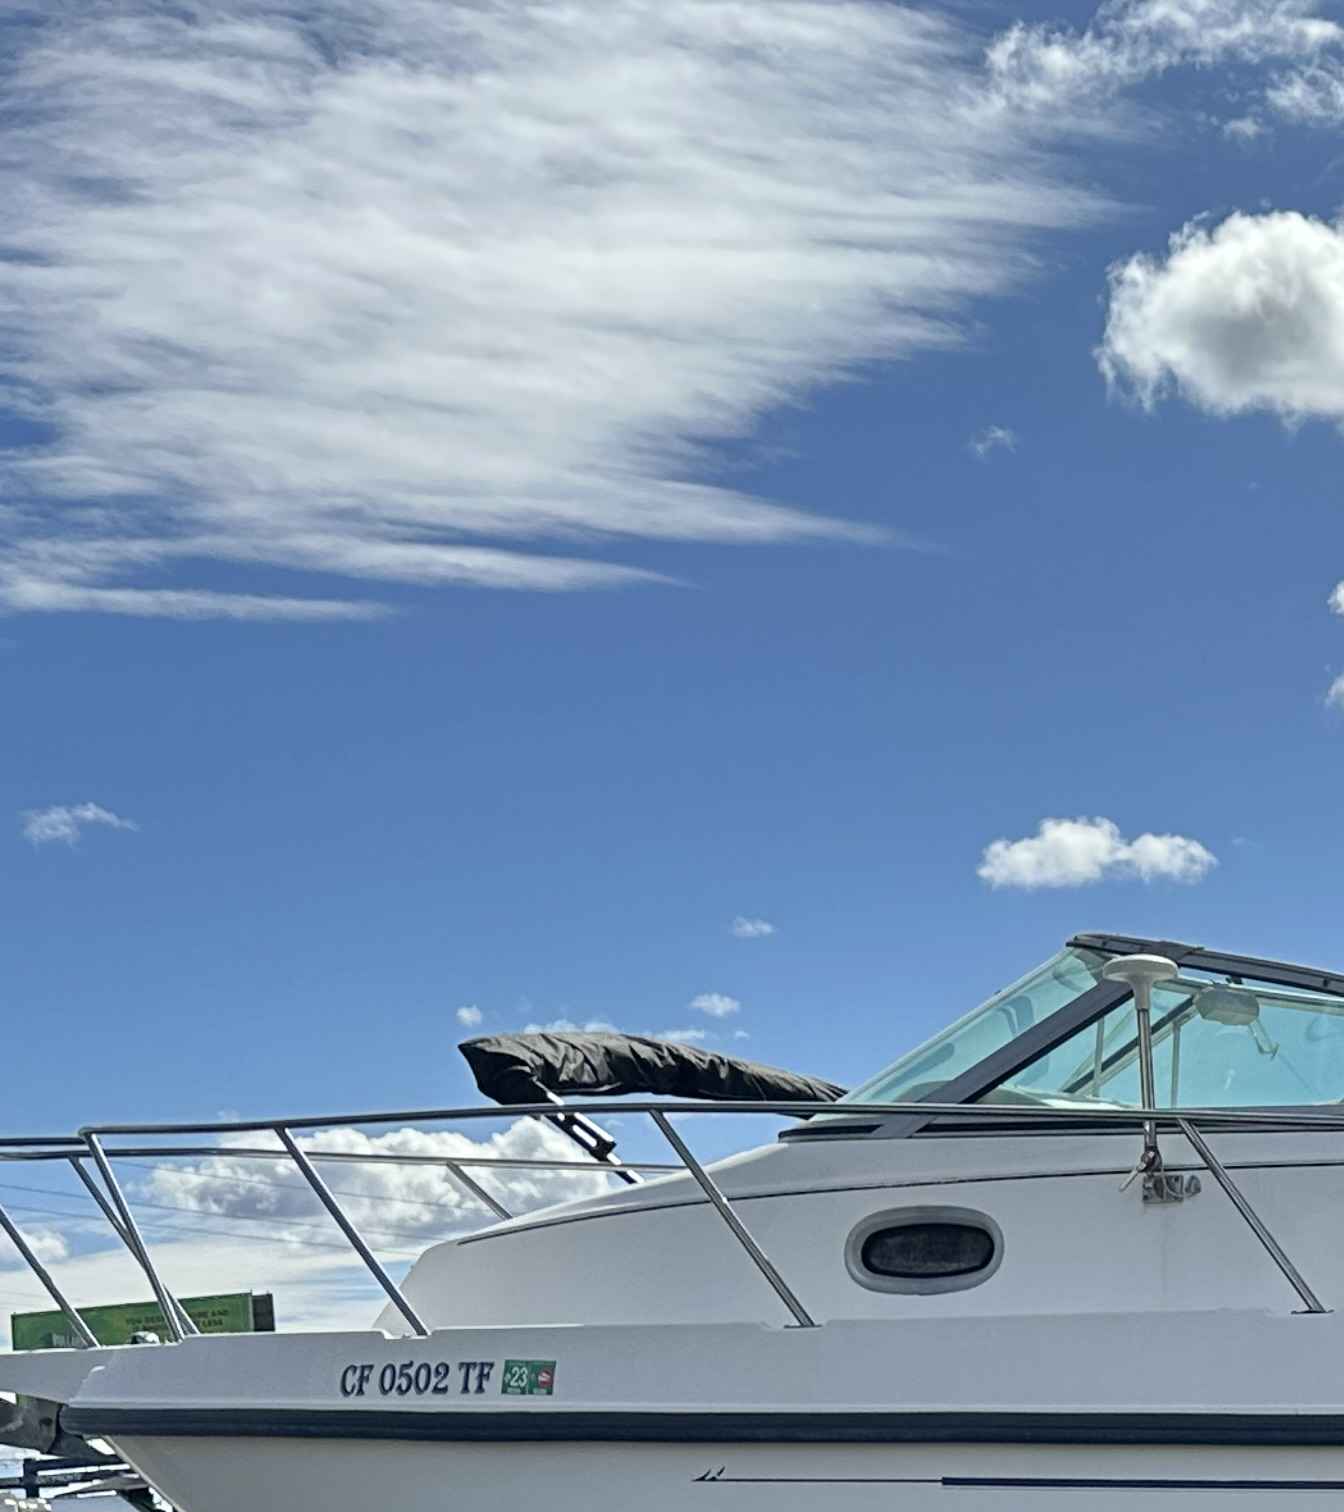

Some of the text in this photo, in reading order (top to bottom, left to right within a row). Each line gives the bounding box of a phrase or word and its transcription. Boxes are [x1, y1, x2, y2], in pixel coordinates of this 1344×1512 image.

[340, 1360, 495, 1397] CF 0502 TF
[510, 1366, 529, 1387] 23
